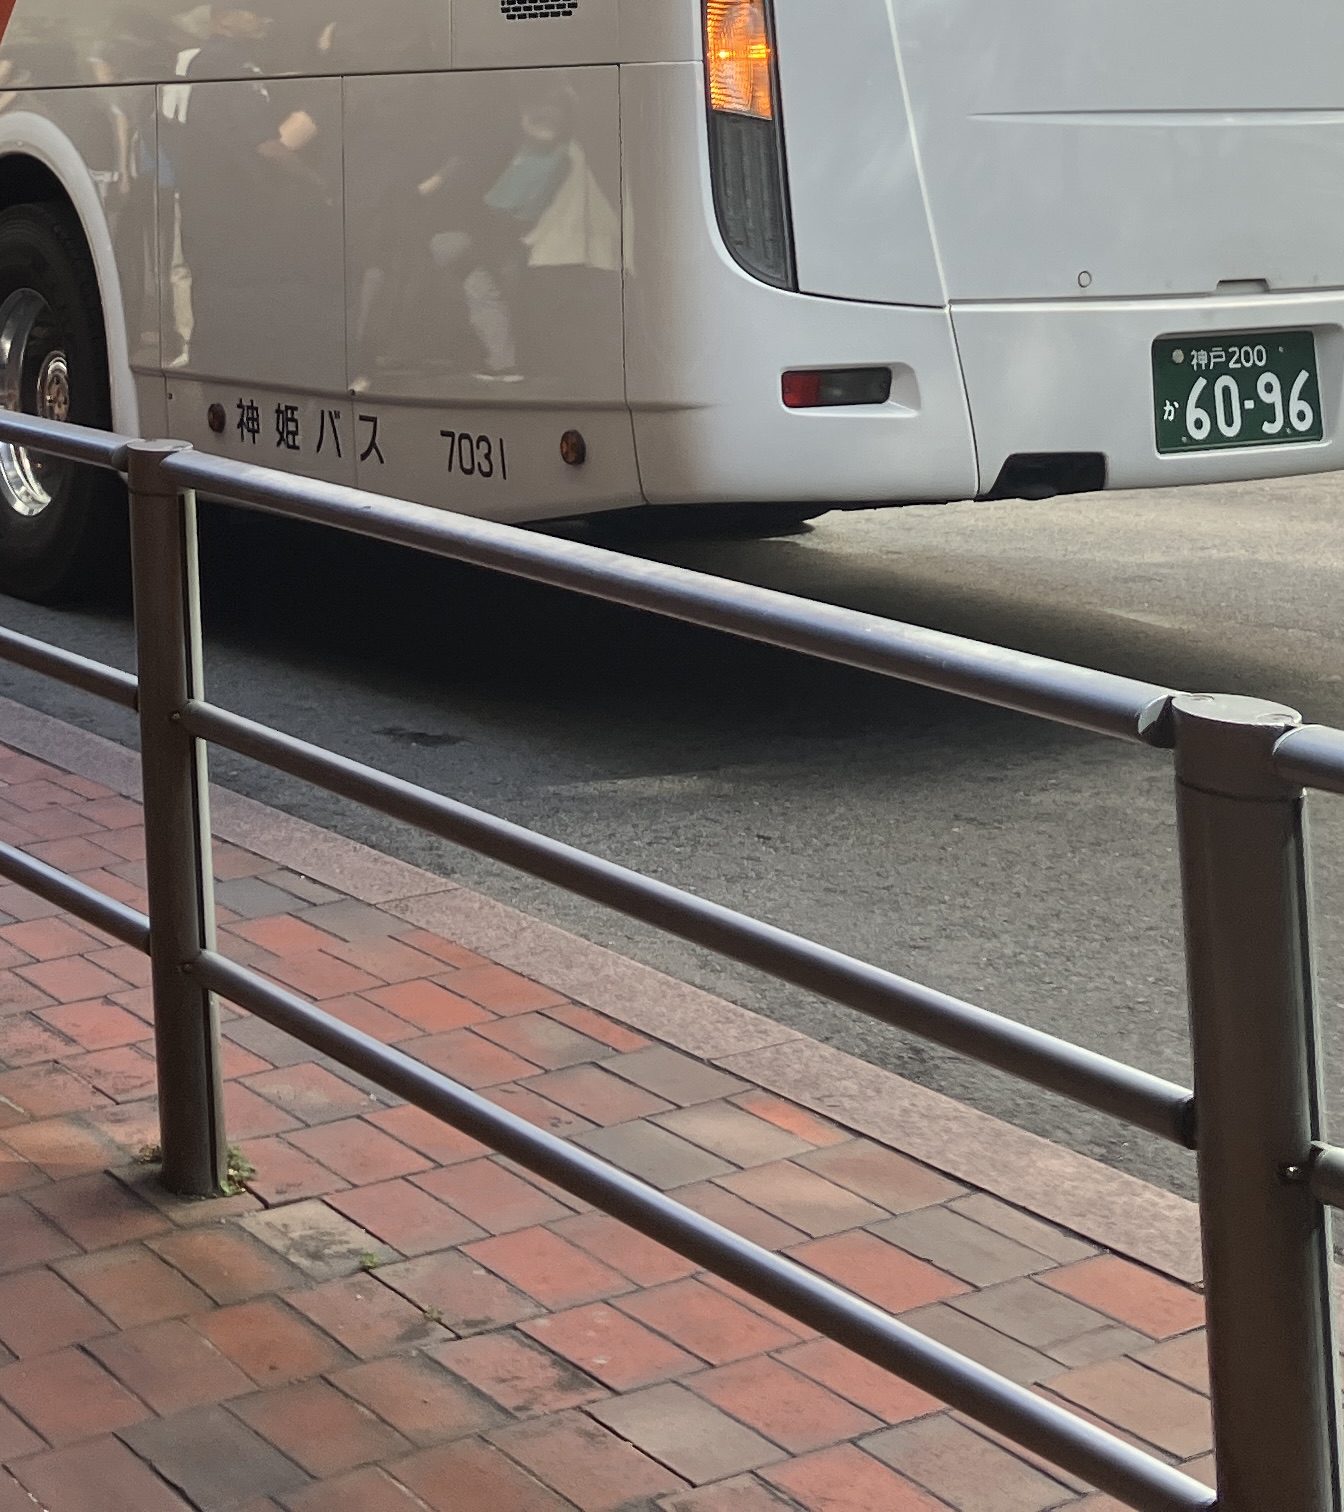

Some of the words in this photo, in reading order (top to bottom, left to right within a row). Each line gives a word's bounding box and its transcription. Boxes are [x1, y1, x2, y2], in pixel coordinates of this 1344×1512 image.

[1190, 344, 1267, 371] 神戸200
[237, 398, 384, 464] 神姫バス
[440, 430, 507, 480] 7031
[1163, 399, 1179, 422] か
[1186, 369, 1314, 440] 60-96
